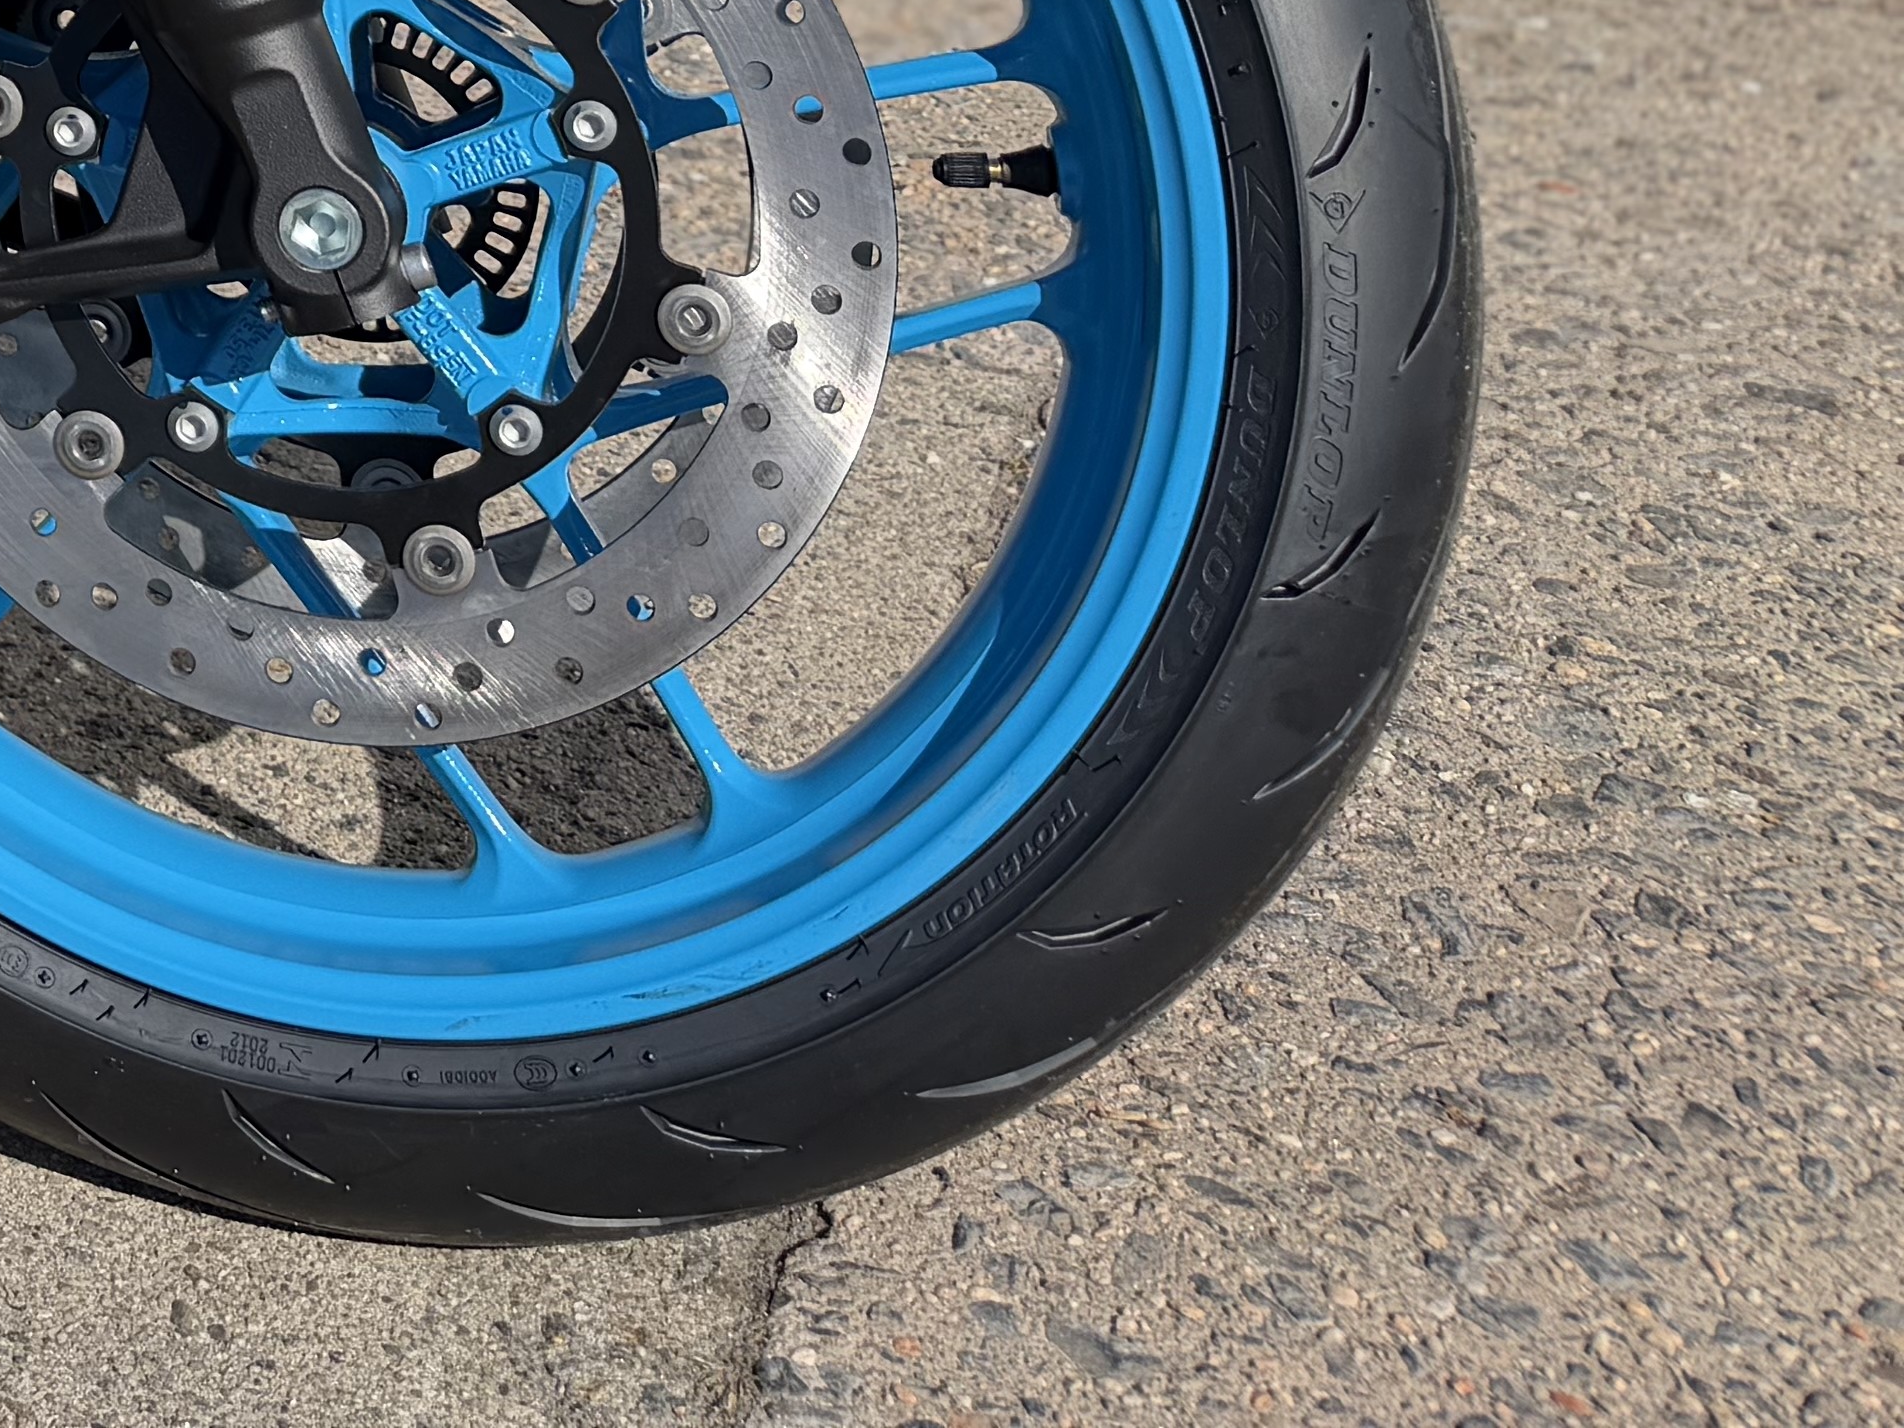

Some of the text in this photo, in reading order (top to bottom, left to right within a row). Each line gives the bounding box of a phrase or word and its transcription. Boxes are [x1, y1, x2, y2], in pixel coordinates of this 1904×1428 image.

[445, 127, 521, 171] JAPAN
[447, 148, 532, 192] YAMAHA
[1303, 242, 1360, 547] DUNLOP
[1186, 364, 1276, 654] DUNLOP
[924, 797, 1080, 941] ROTATION
[227, 1030, 269, 1054] 2012
